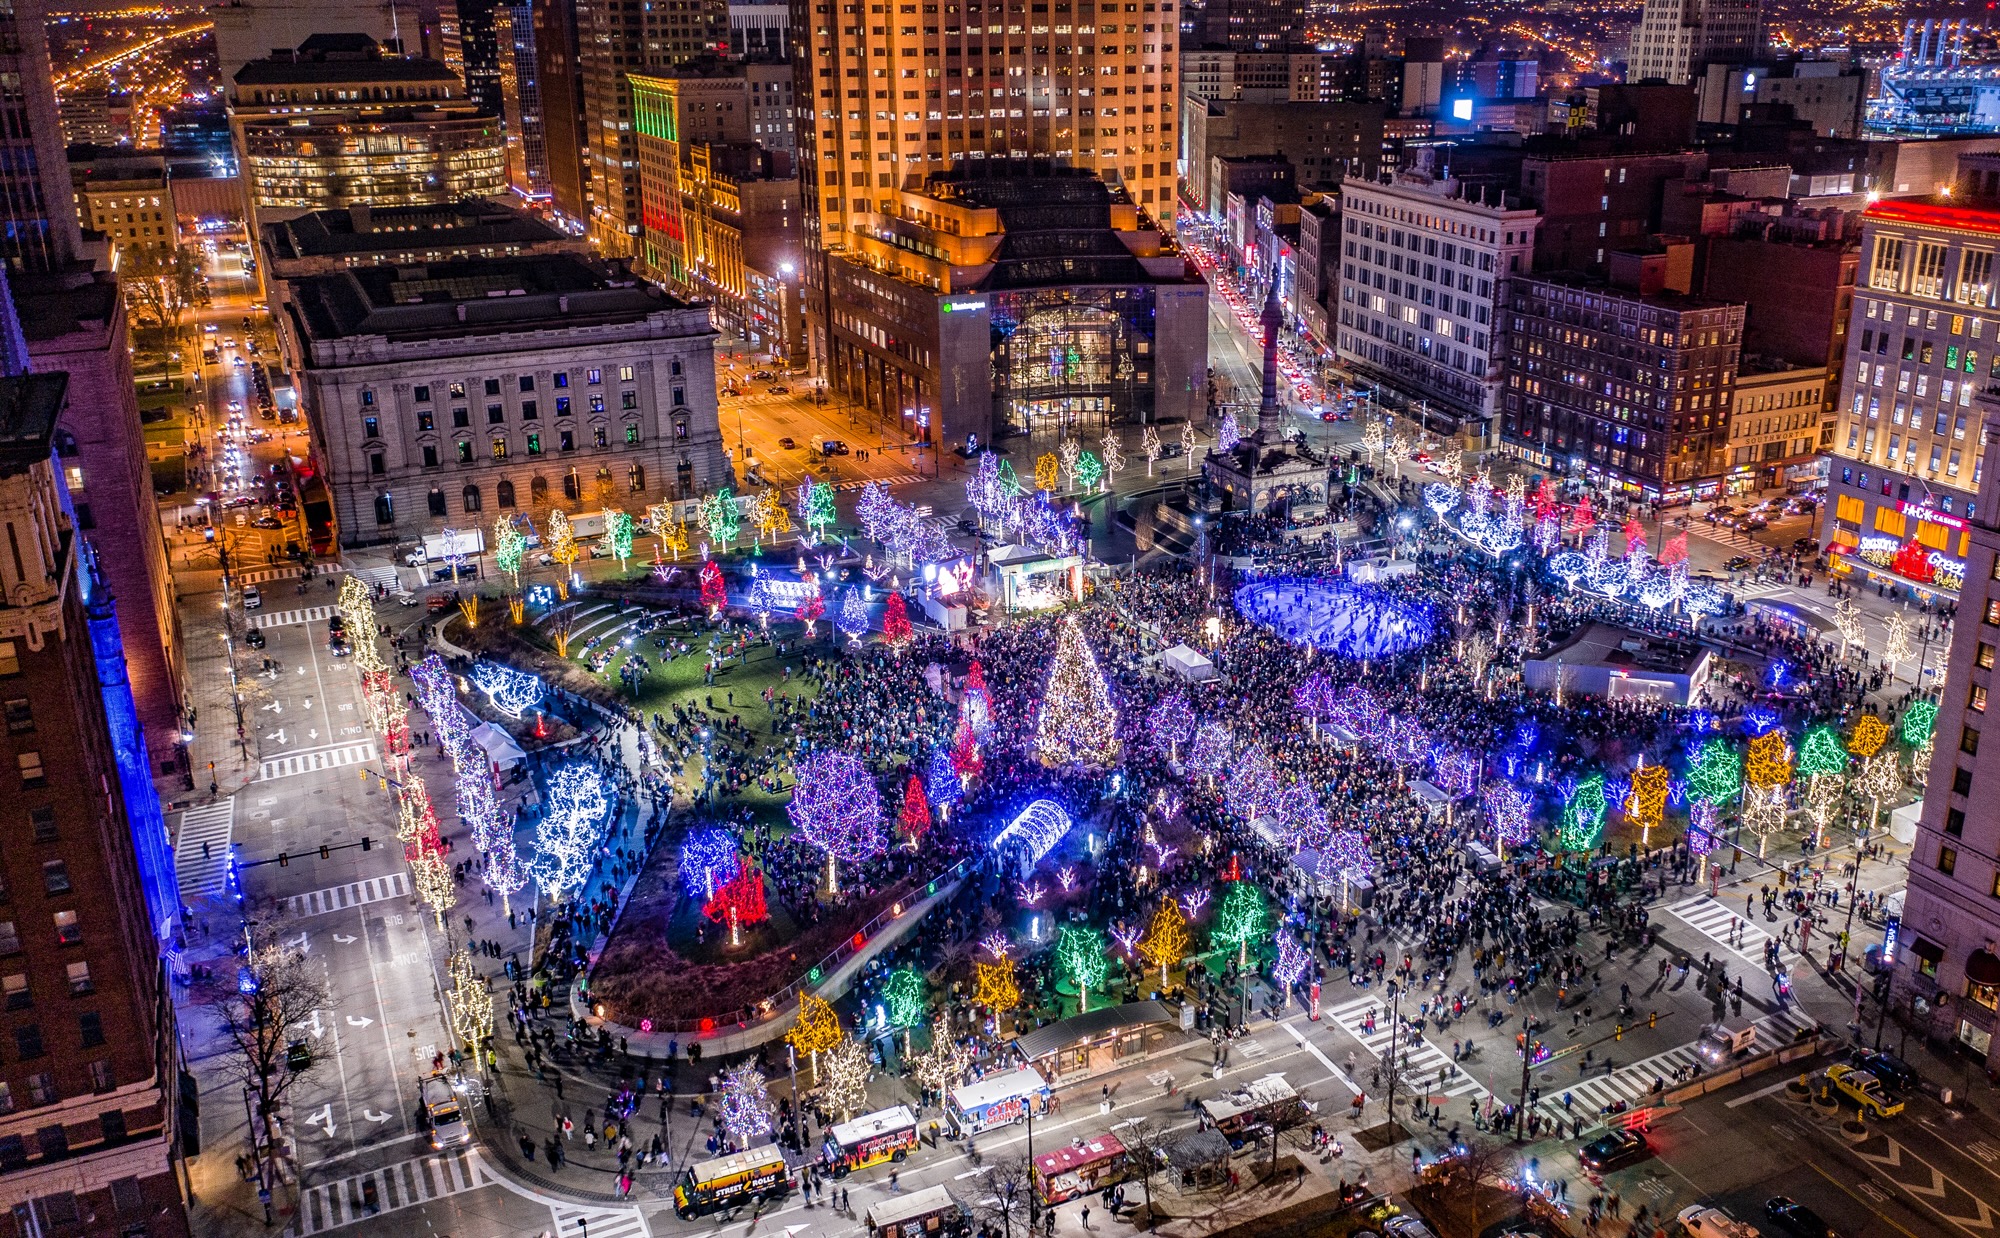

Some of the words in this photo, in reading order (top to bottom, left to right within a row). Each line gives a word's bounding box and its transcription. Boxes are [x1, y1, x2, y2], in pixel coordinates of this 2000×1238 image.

[1745, 431, 1806, 445] SOUTHWORTH
[1902, 502, 1932, 523] JACK
[327, 663, 347, 672] ONLY
[338, 703, 353, 711] BUS
[340, 726, 362, 736] ONLY
[385, 914, 403, 927] BUS
[391, 952, 418, 968] ONLY
[415, 1045, 436, 1061] BUS
[987, 1100, 1022, 1117] GYRO
[987, 1111, 1022, 1125] GEORGE
[869, 1143, 886, 1155] TACO
[887, 1138, 908, 1150] TRUCK
[715, 1185, 743, 1198] STREET
[752, 1175, 776, 1187] ROLLS
